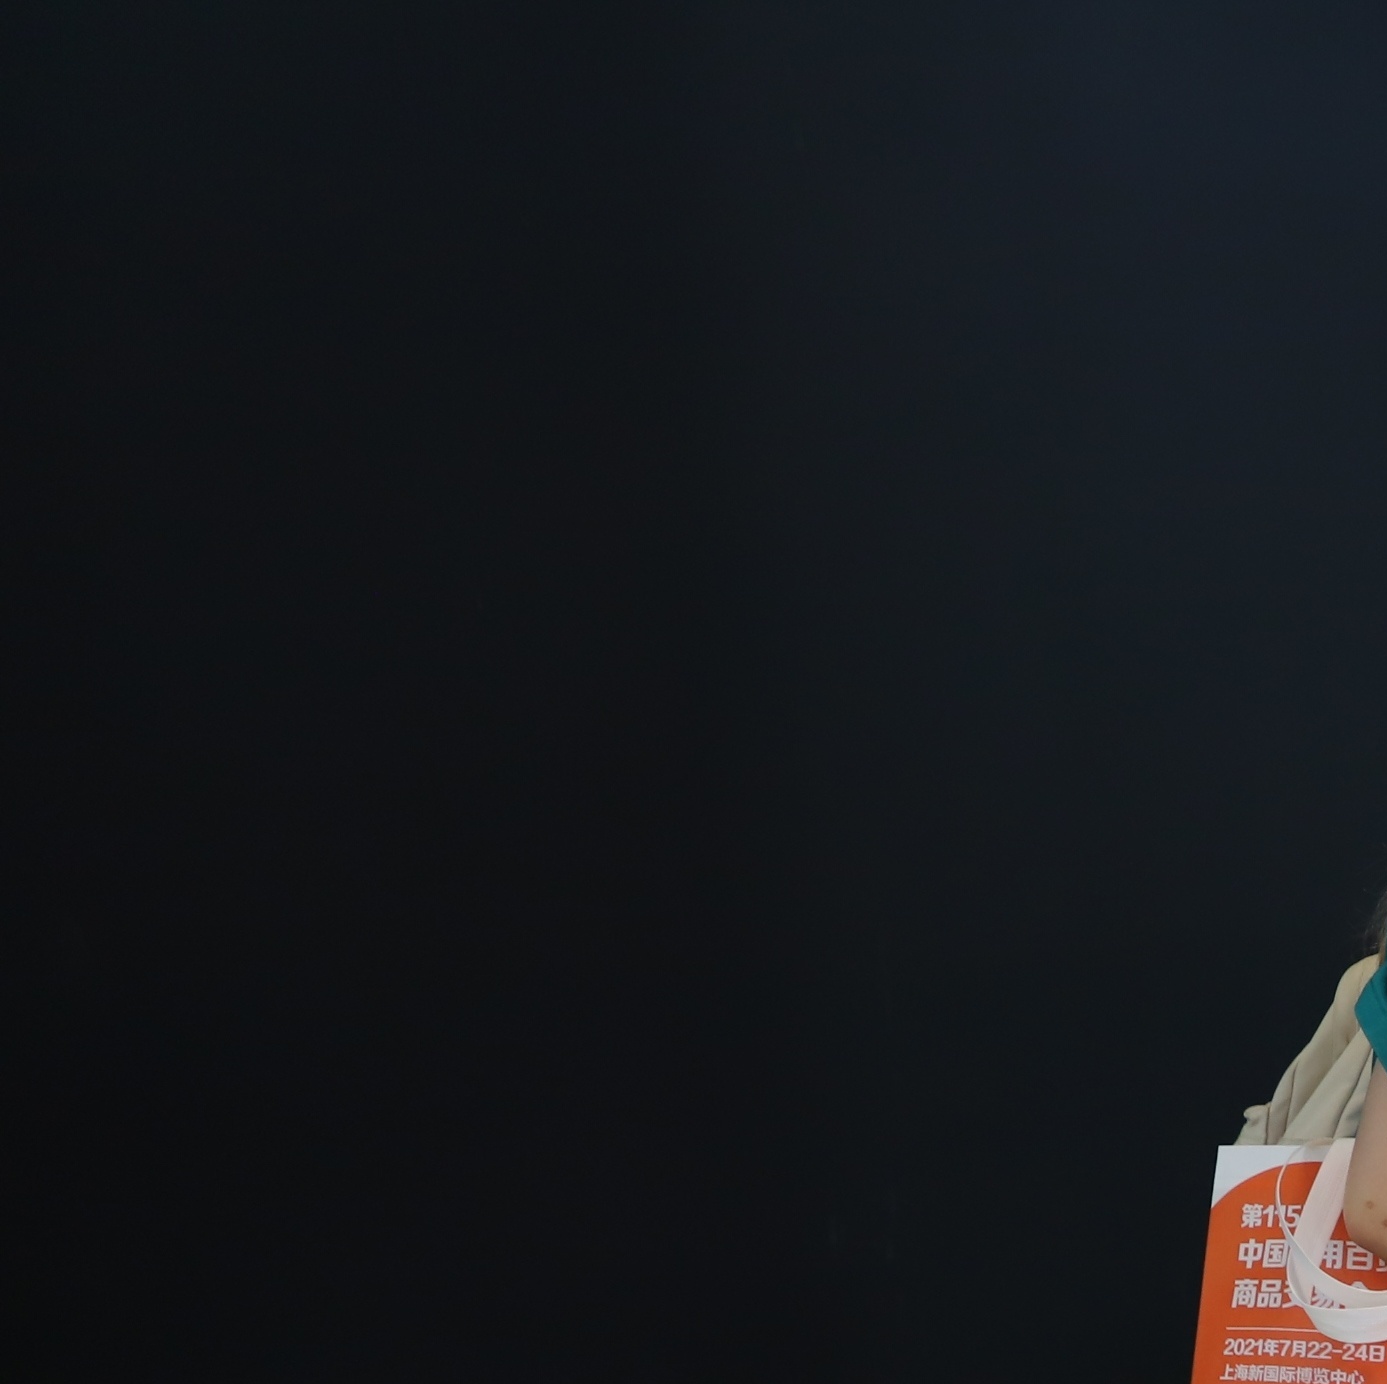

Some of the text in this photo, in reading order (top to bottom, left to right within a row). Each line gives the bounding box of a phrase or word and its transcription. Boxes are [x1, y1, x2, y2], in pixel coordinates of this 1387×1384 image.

[1241, 1203, 1302, 1229] 第115
[1223, 1338, 1386, 1363] 2021年7月22-24日
